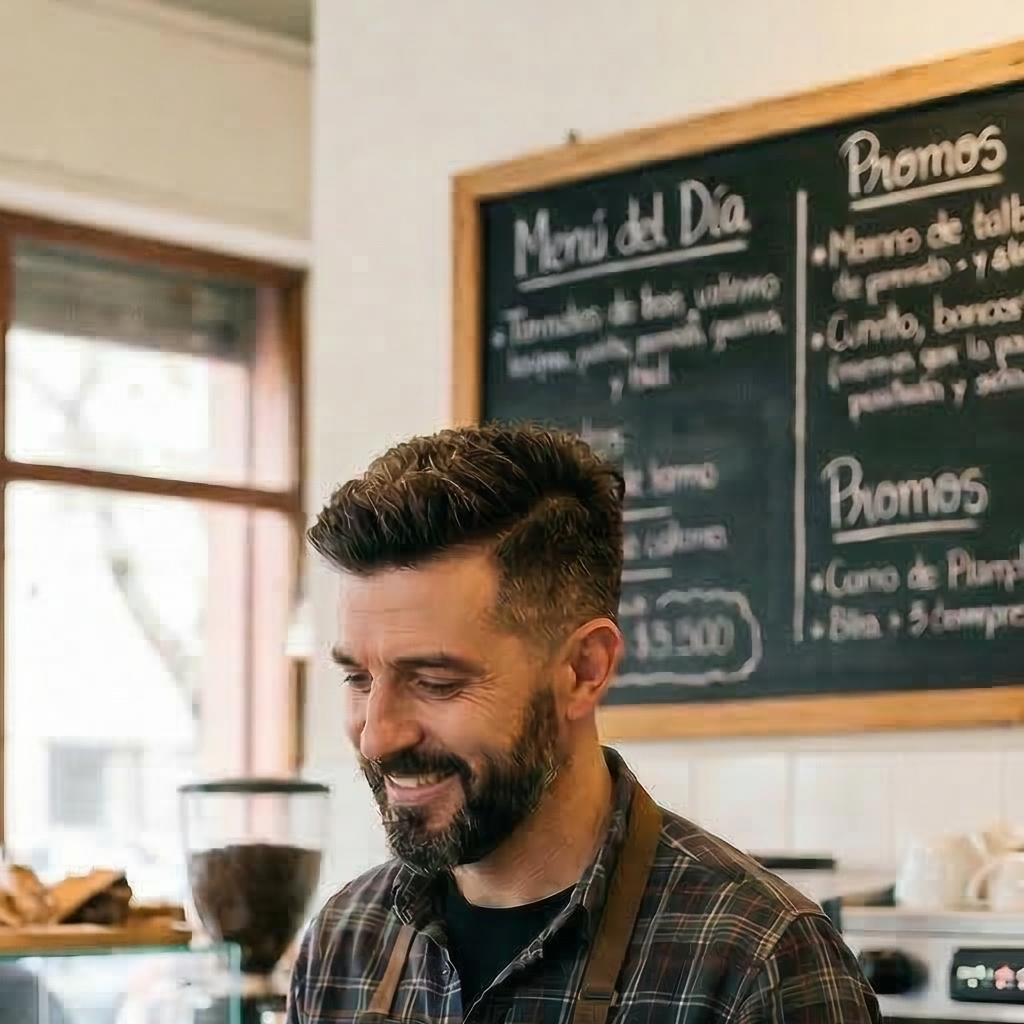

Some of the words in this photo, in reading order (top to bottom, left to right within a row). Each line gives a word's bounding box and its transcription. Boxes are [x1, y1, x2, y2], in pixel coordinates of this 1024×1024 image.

[839, 124, 1007, 196] Promos
[615, 191, 669, 255] del
[679, 178, 752, 246] Día
[821, 455, 989, 529] Promos
